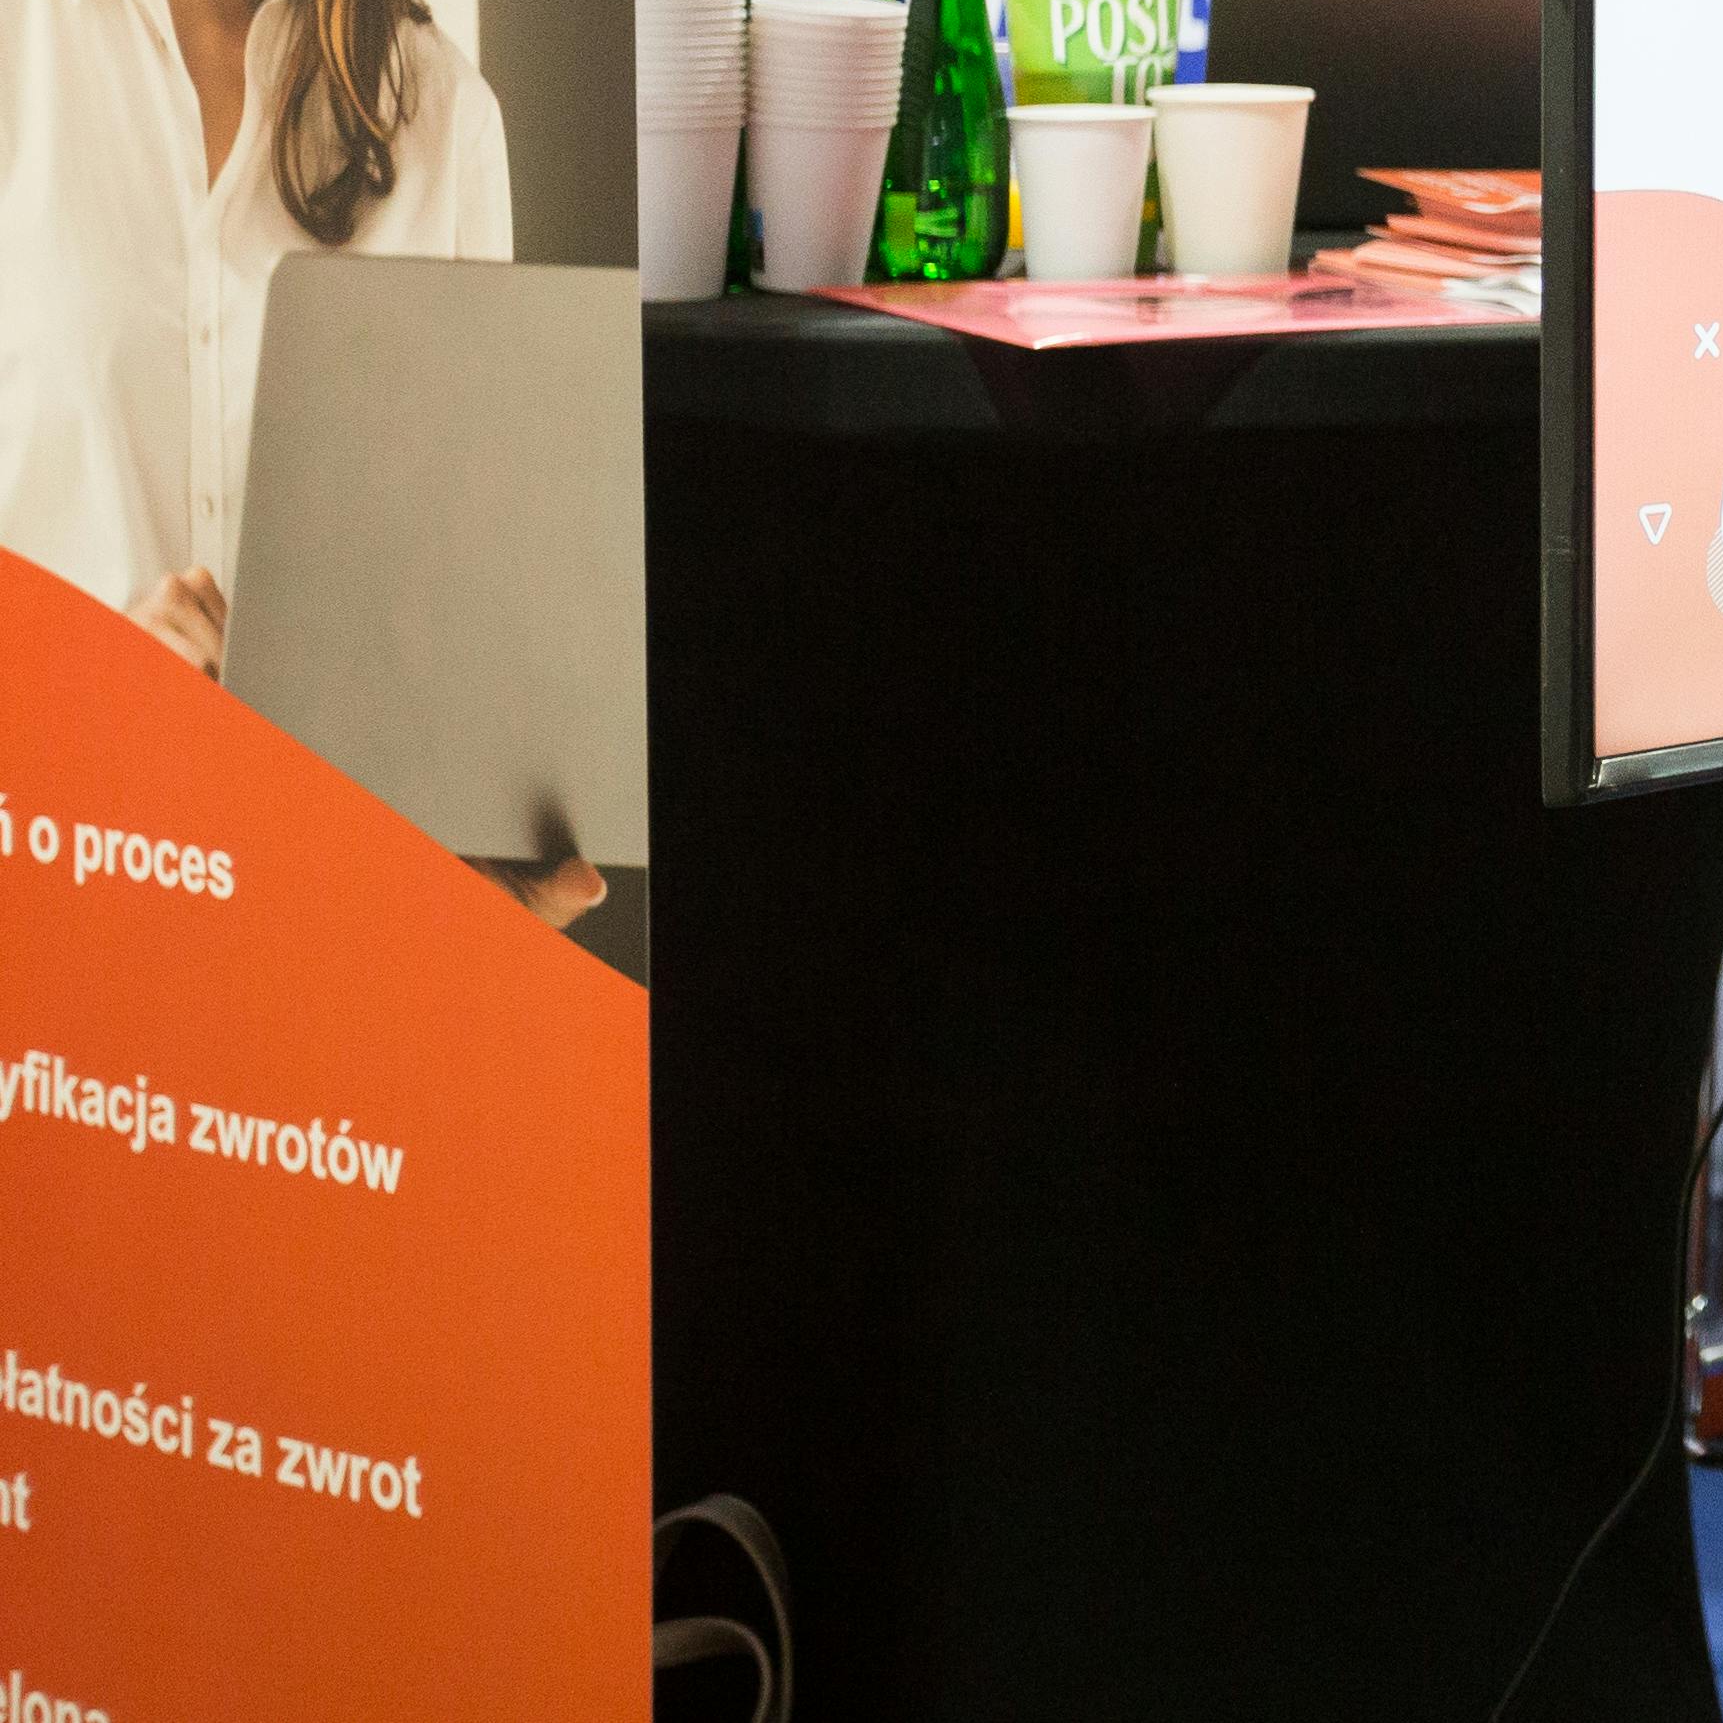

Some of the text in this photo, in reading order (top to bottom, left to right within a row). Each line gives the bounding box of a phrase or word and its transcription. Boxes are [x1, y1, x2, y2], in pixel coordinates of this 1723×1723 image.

[28, 814, 59, 864] o
[74, 821, 235, 901] proces
[187, 1101, 405, 1195] zwrotów
[0, 1349, 424, 1520] łatności za zwrot
